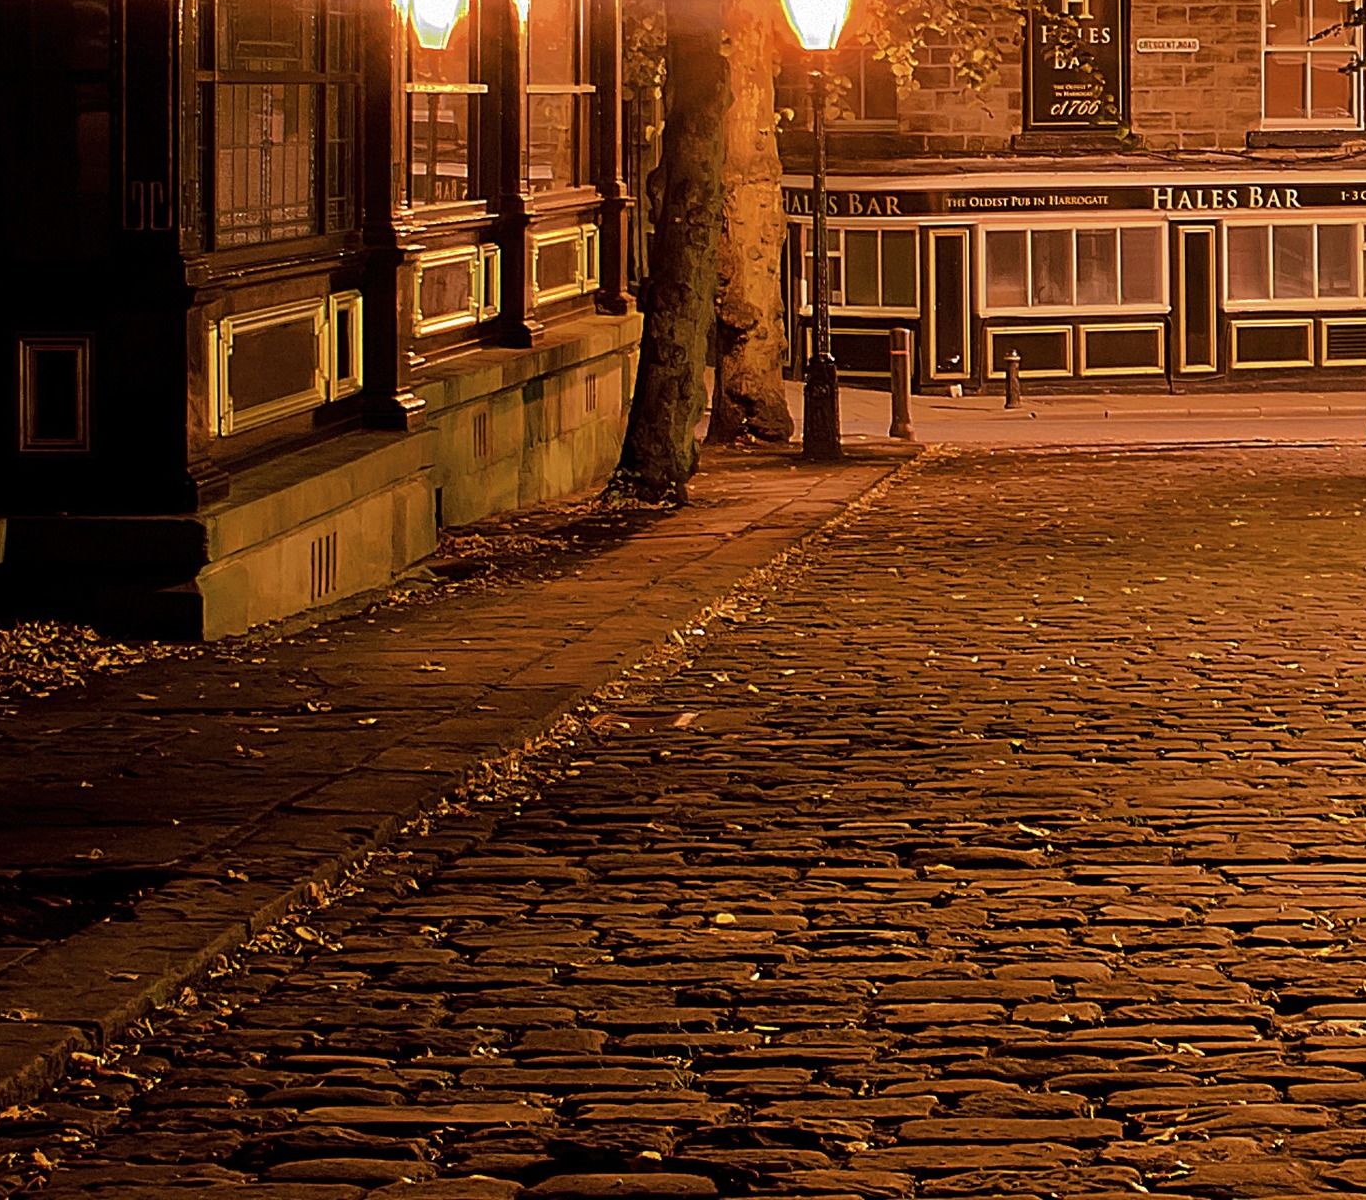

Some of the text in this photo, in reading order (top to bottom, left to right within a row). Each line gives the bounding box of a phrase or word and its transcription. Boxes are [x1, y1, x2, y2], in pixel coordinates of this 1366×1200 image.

[1041, 25, 1111, 44] HES
[782, 190, 902, 215] HALS BAR
[947, 195, 1109, 208] THE OLDEST PUB IN HARROGATE
[1152, 186, 1302, 210] HALES BAR
